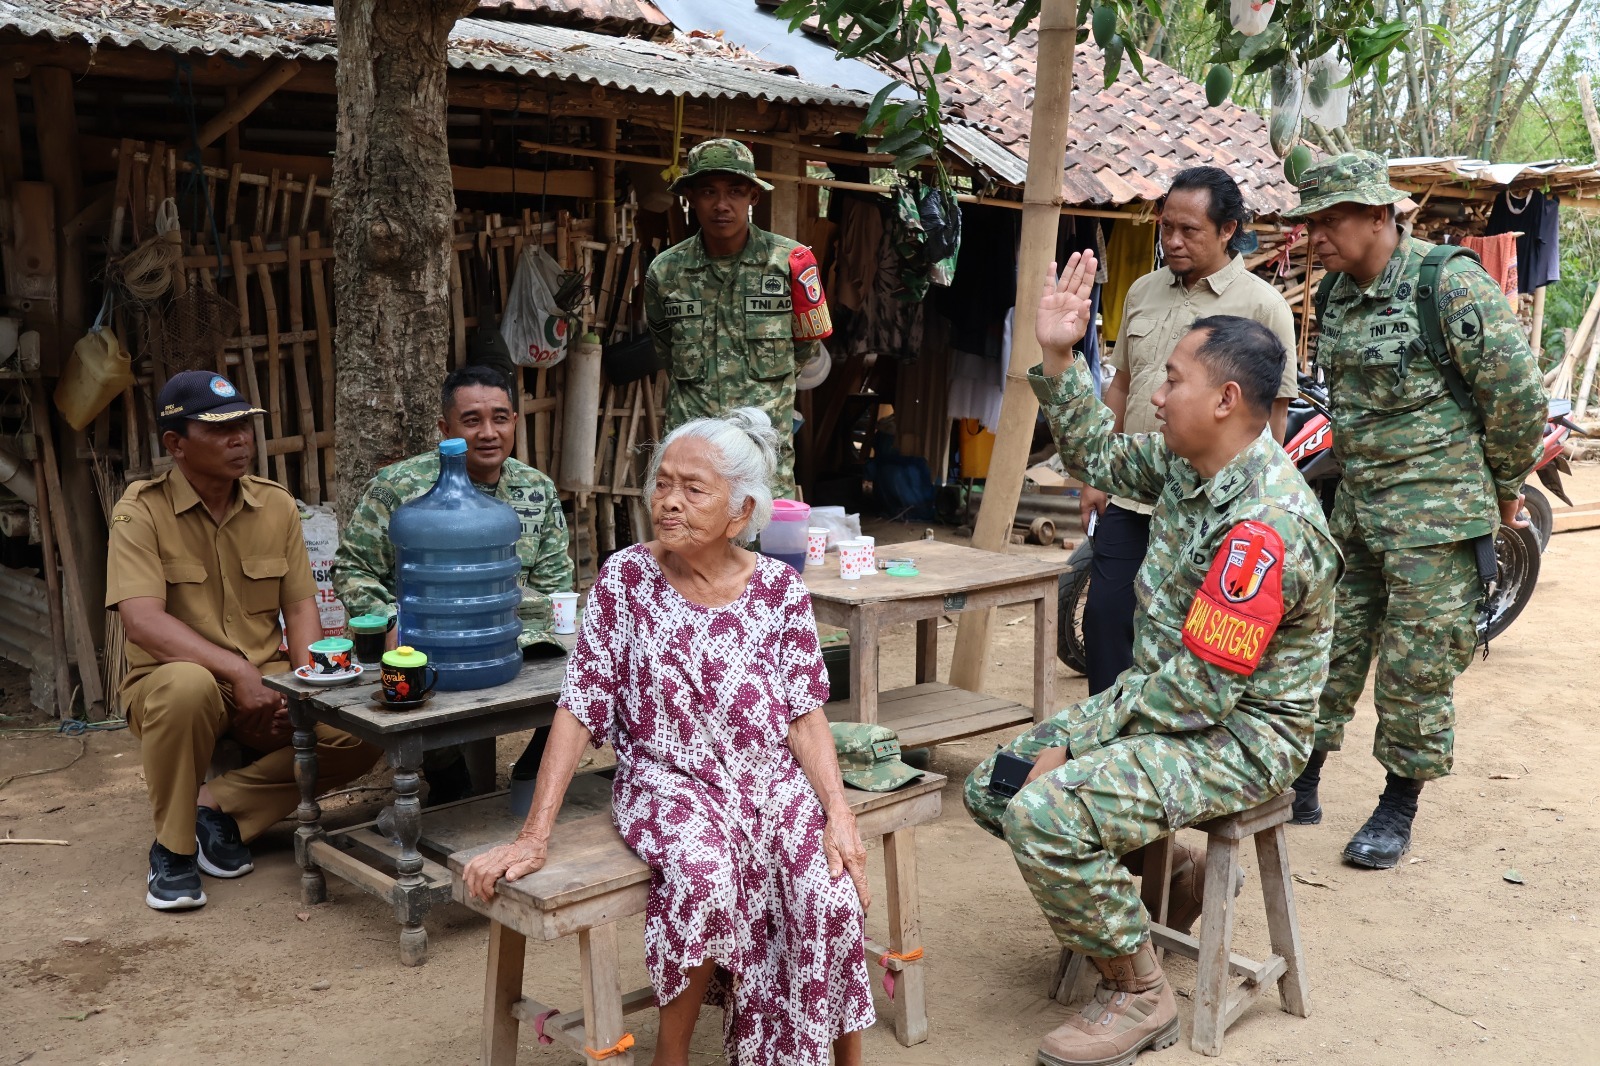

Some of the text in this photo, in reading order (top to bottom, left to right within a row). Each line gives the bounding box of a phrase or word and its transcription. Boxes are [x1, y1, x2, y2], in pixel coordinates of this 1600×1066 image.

[687, 304, 695, 314] R
[750, 299, 791, 310] TNI AD
[1369, 323, 1409, 337] TNI AD
[1188, 546, 1206, 565] AD
[1185, 597, 1265, 661] DAN SATGAS
